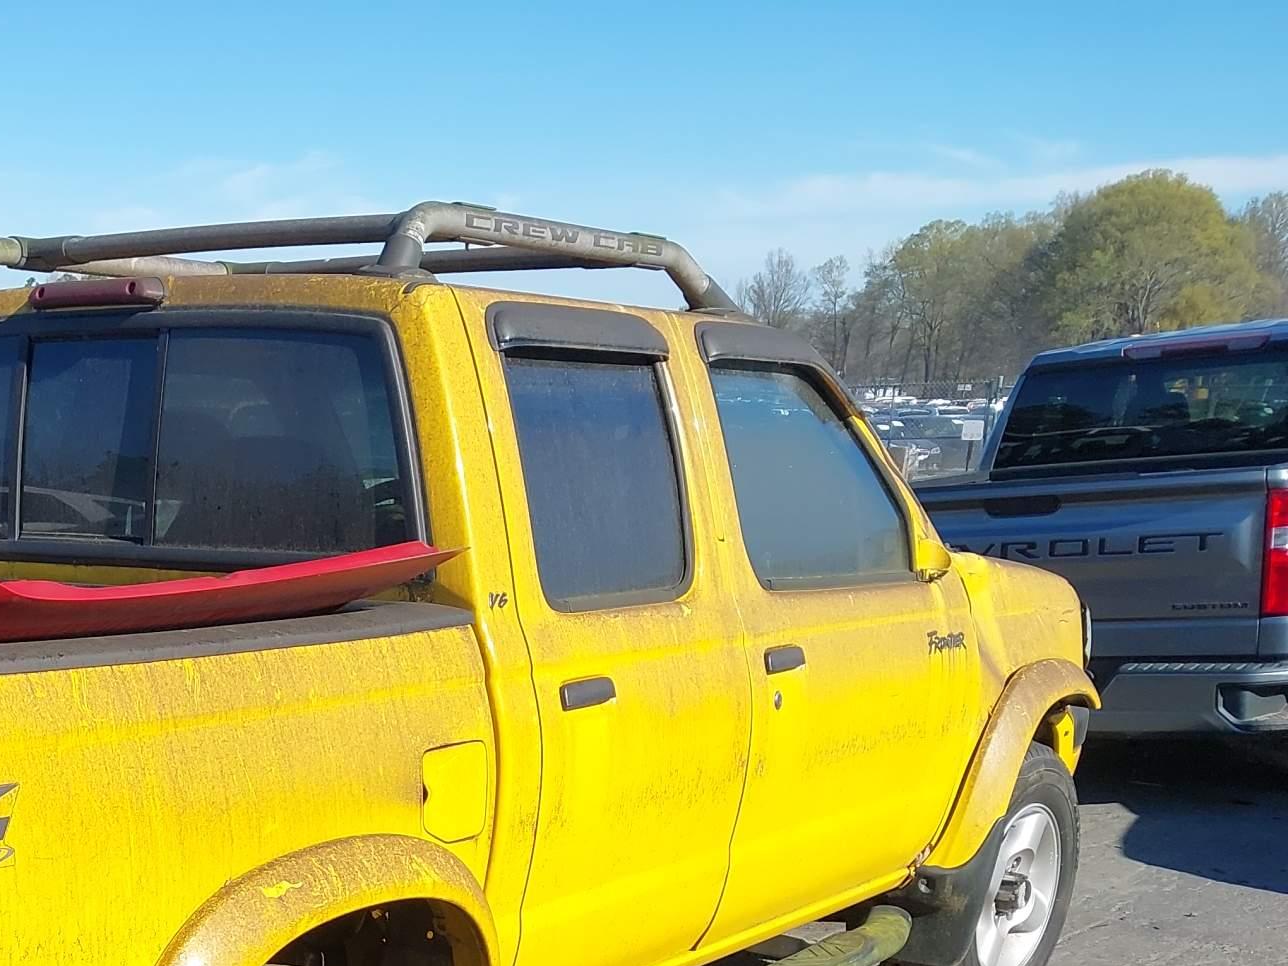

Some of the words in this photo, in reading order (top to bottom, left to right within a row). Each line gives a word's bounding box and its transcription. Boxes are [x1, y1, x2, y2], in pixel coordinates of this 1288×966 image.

[465, 213, 580, 244] CREW
[593, 232, 663, 257] CAB
[951, 532, 1224, 559] VROLET
[488, 591, 509, 610] V6
[1171, 601, 1249, 611] CUSTOM
